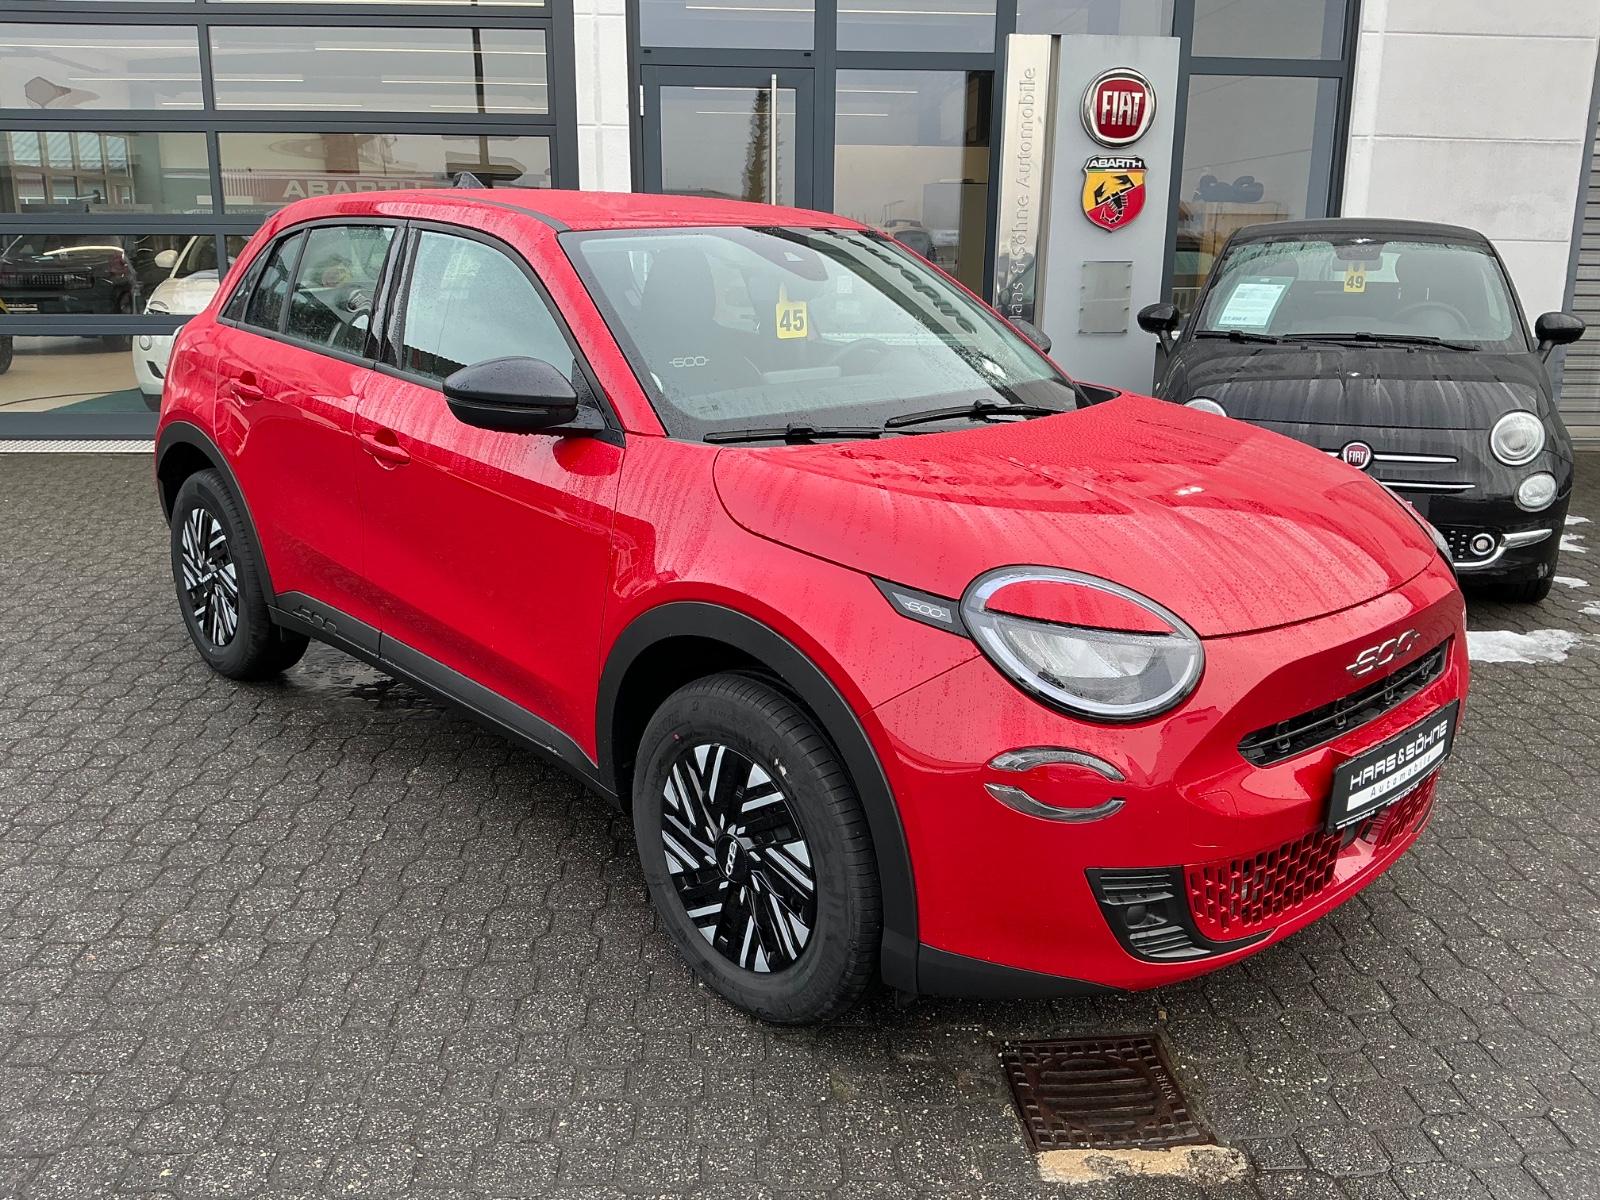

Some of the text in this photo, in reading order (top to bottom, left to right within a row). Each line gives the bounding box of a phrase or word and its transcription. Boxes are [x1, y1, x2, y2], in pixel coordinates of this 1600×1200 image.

[1101, 91, 1143, 126] FIAT
[1016, 67, 1036, 188] Automobile
[1089, 159, 1142, 168] ABARTH
[1346, 275, 1364, 288] 49
[779, 309, 805, 332] 45
[669, 356, 710, 368] 600
[1348, 450, 1366, 464] FIAT
[905, 601, 946, 618] 600
[1346, 629, 1421, 678] 600
[1369, 754, 1431, 799] Automobile
